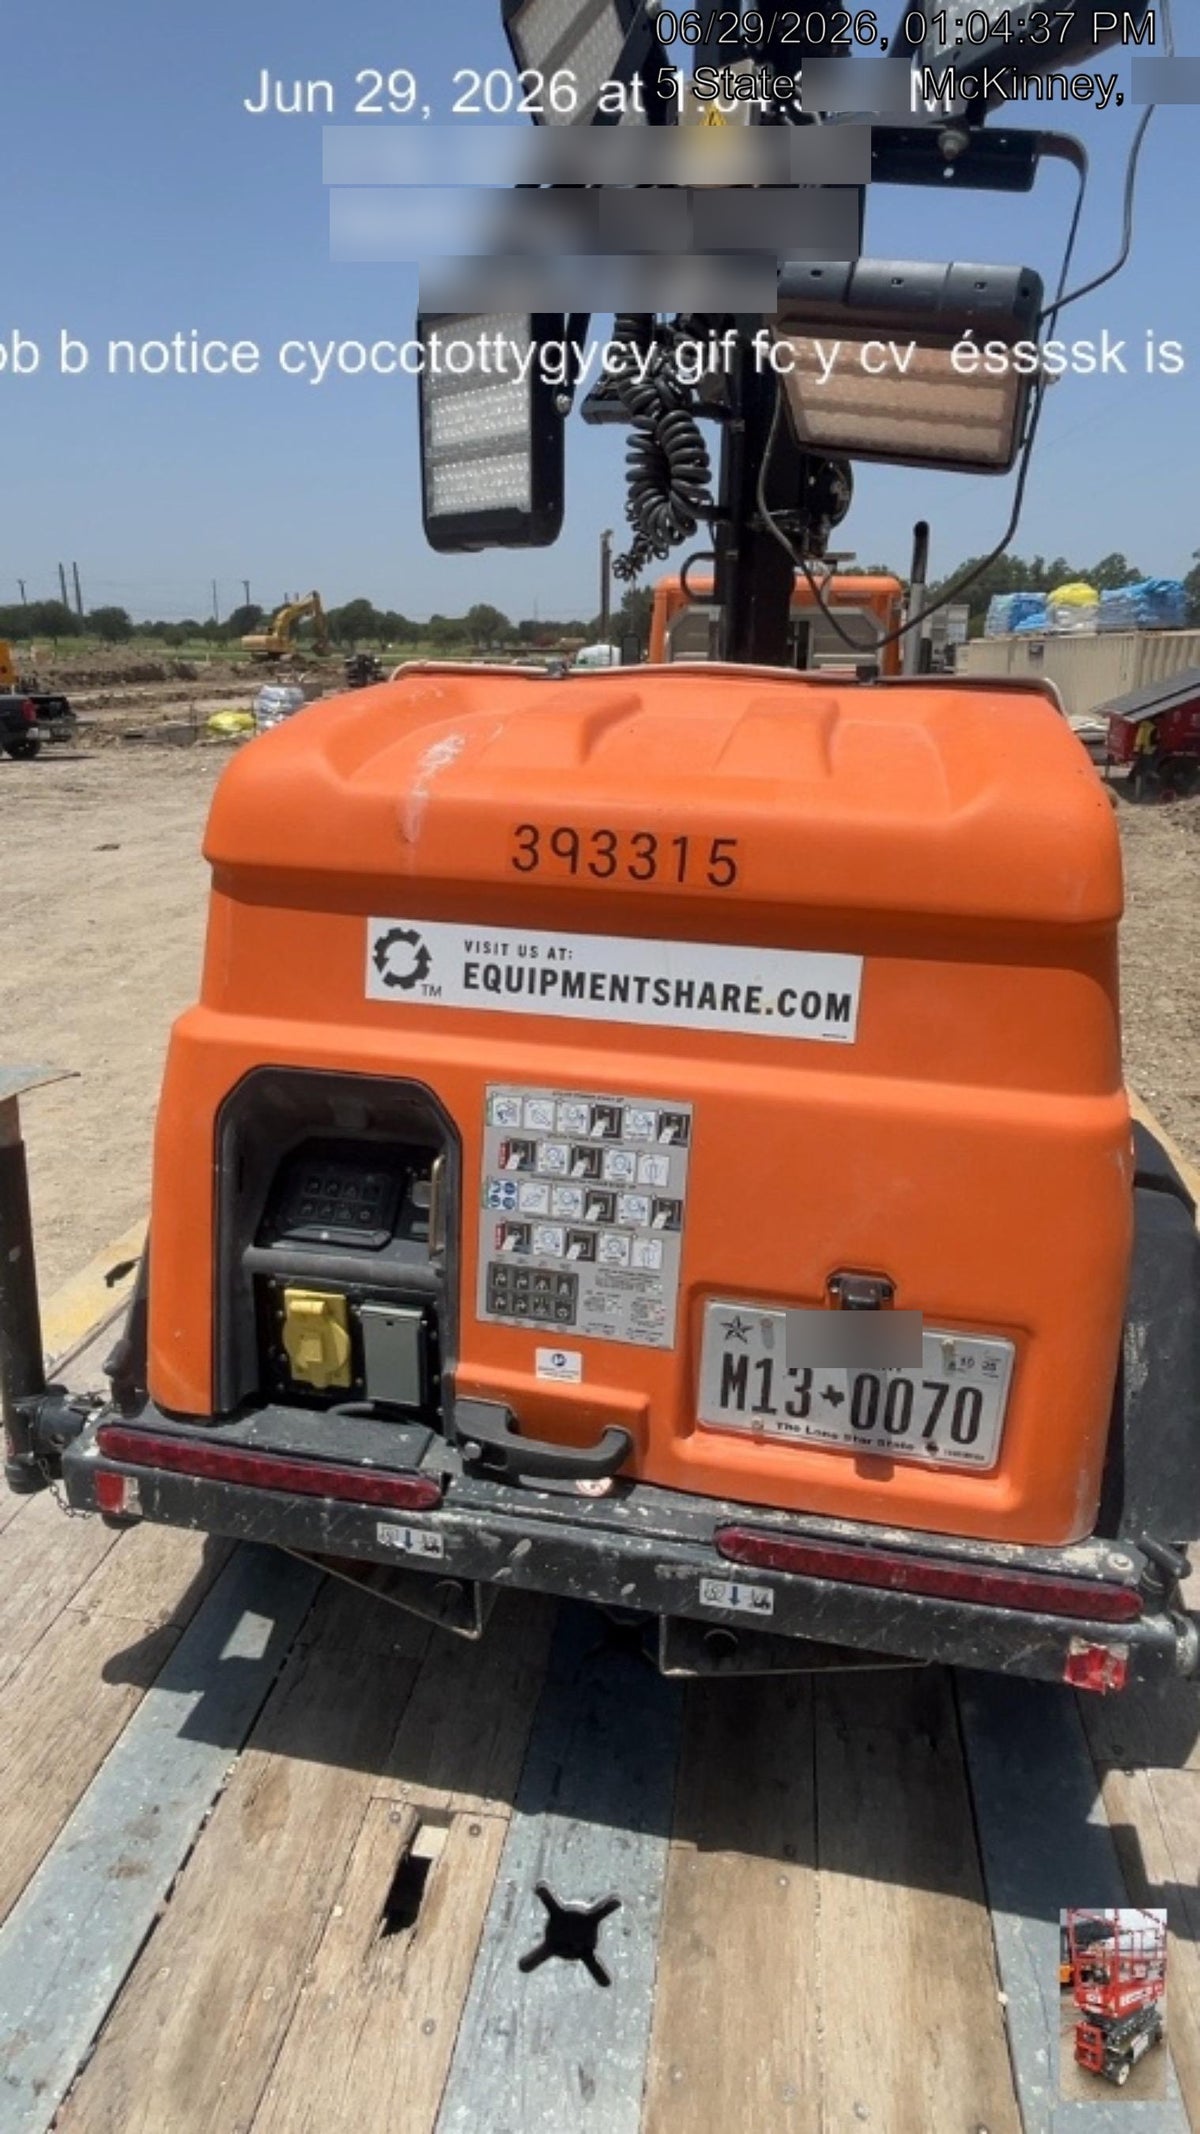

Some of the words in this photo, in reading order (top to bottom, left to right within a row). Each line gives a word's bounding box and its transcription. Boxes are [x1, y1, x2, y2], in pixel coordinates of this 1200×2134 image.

[511, 823, 739, 887] 393315
[464, 940, 509, 956] VISIT
[518, 944, 539, 959] US
[547, 946, 573, 961] AT:
[462, 961, 852, 1023] EQUIPMENTSHARE.COM
